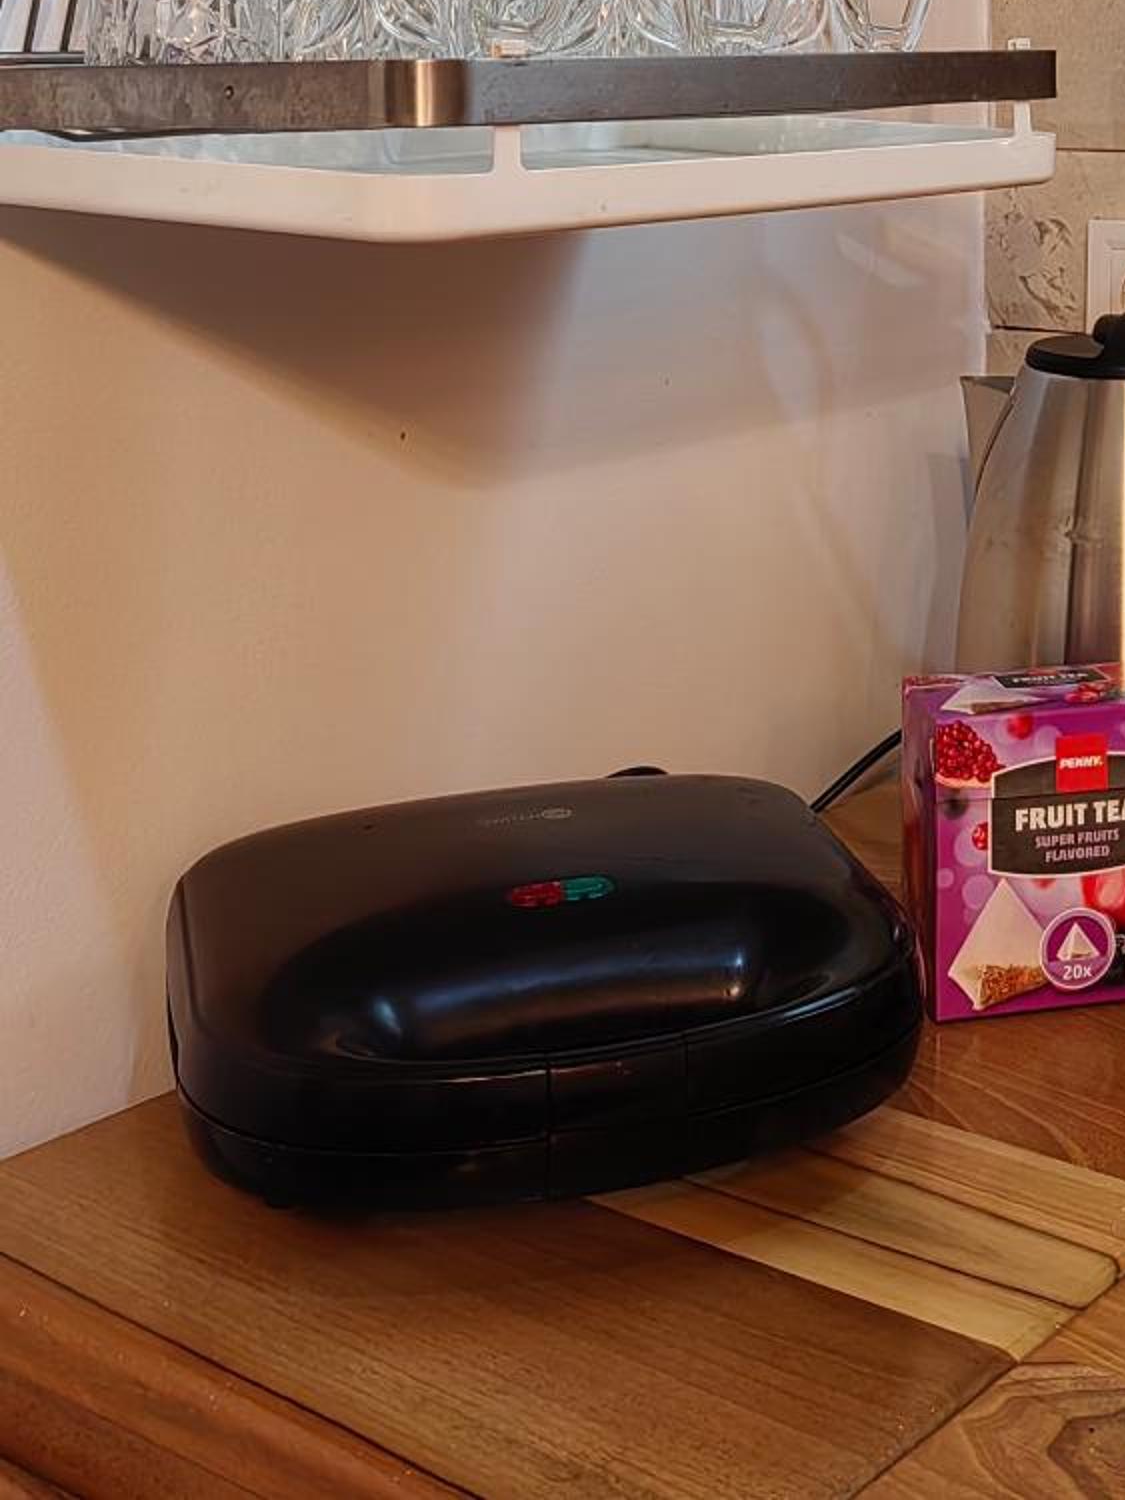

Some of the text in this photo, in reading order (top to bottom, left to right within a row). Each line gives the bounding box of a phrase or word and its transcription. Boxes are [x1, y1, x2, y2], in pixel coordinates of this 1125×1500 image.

[1015, 803, 1088, 832] FRUIT
[1034, 828, 1120, 849] SUPER FRUITS
[1045, 845, 1110, 863] FLAVORED
